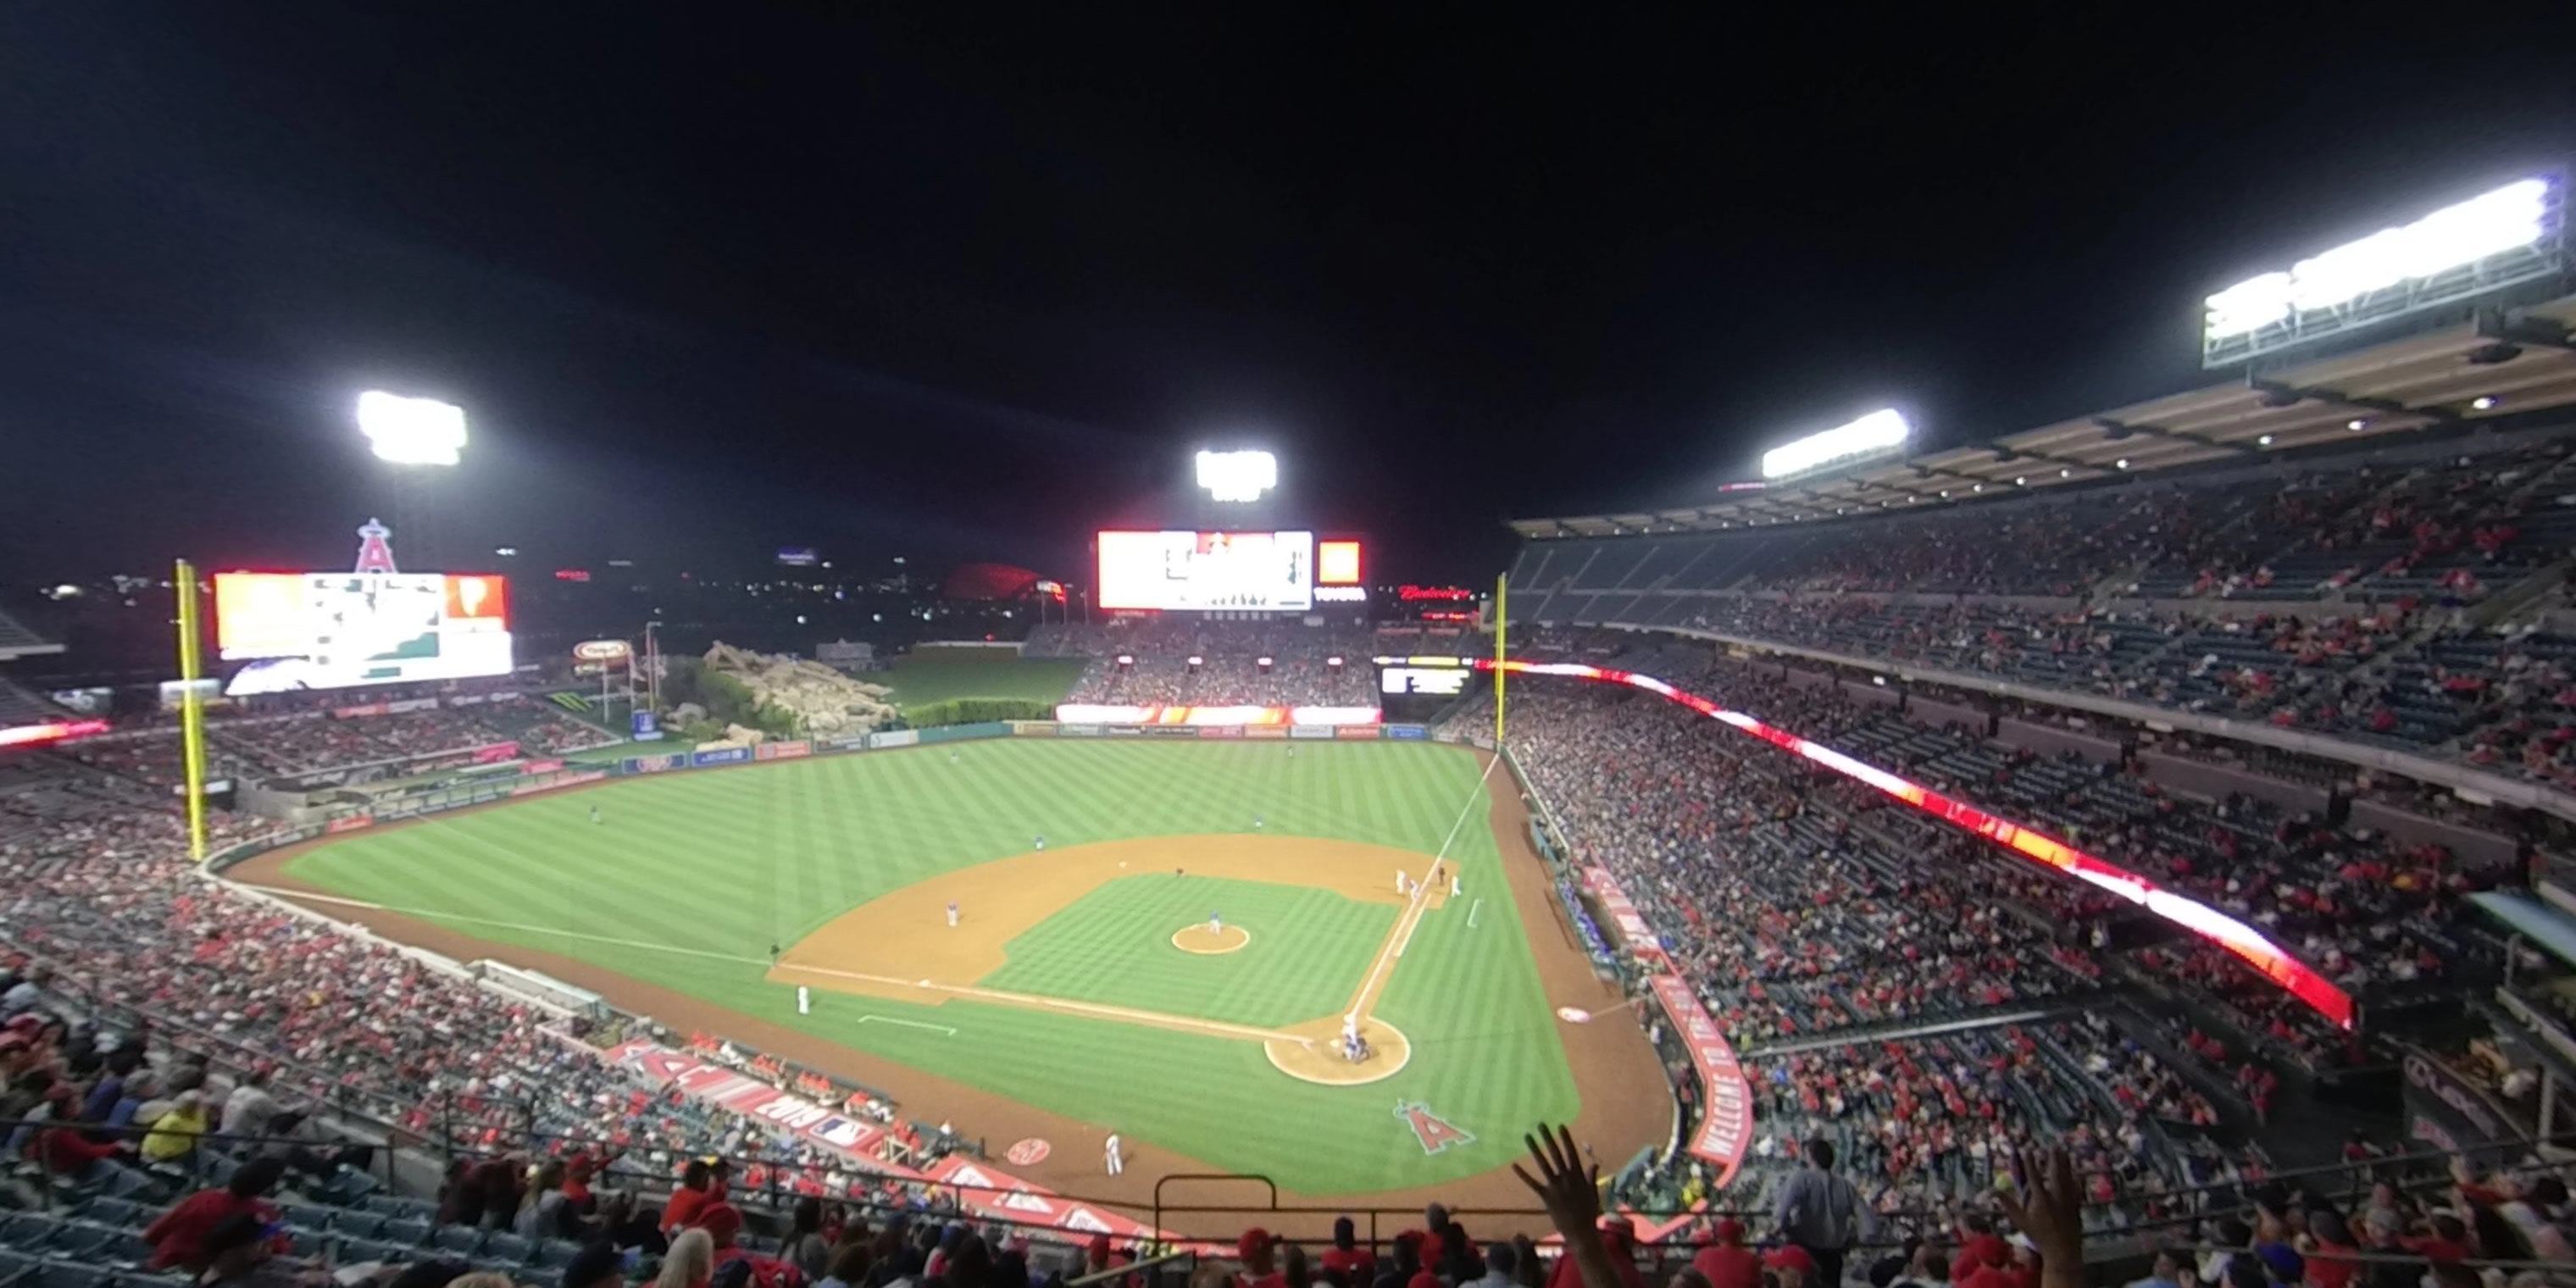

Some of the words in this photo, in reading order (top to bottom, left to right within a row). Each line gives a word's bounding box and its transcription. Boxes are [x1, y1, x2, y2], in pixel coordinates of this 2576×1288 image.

[1313, 586, 1366, 601] TOYOTA
[1702, 1046, 1733, 1067] TO
[753, 1095, 830, 1129] 2019
[1700, 1073, 1743, 1158] WELCOME
